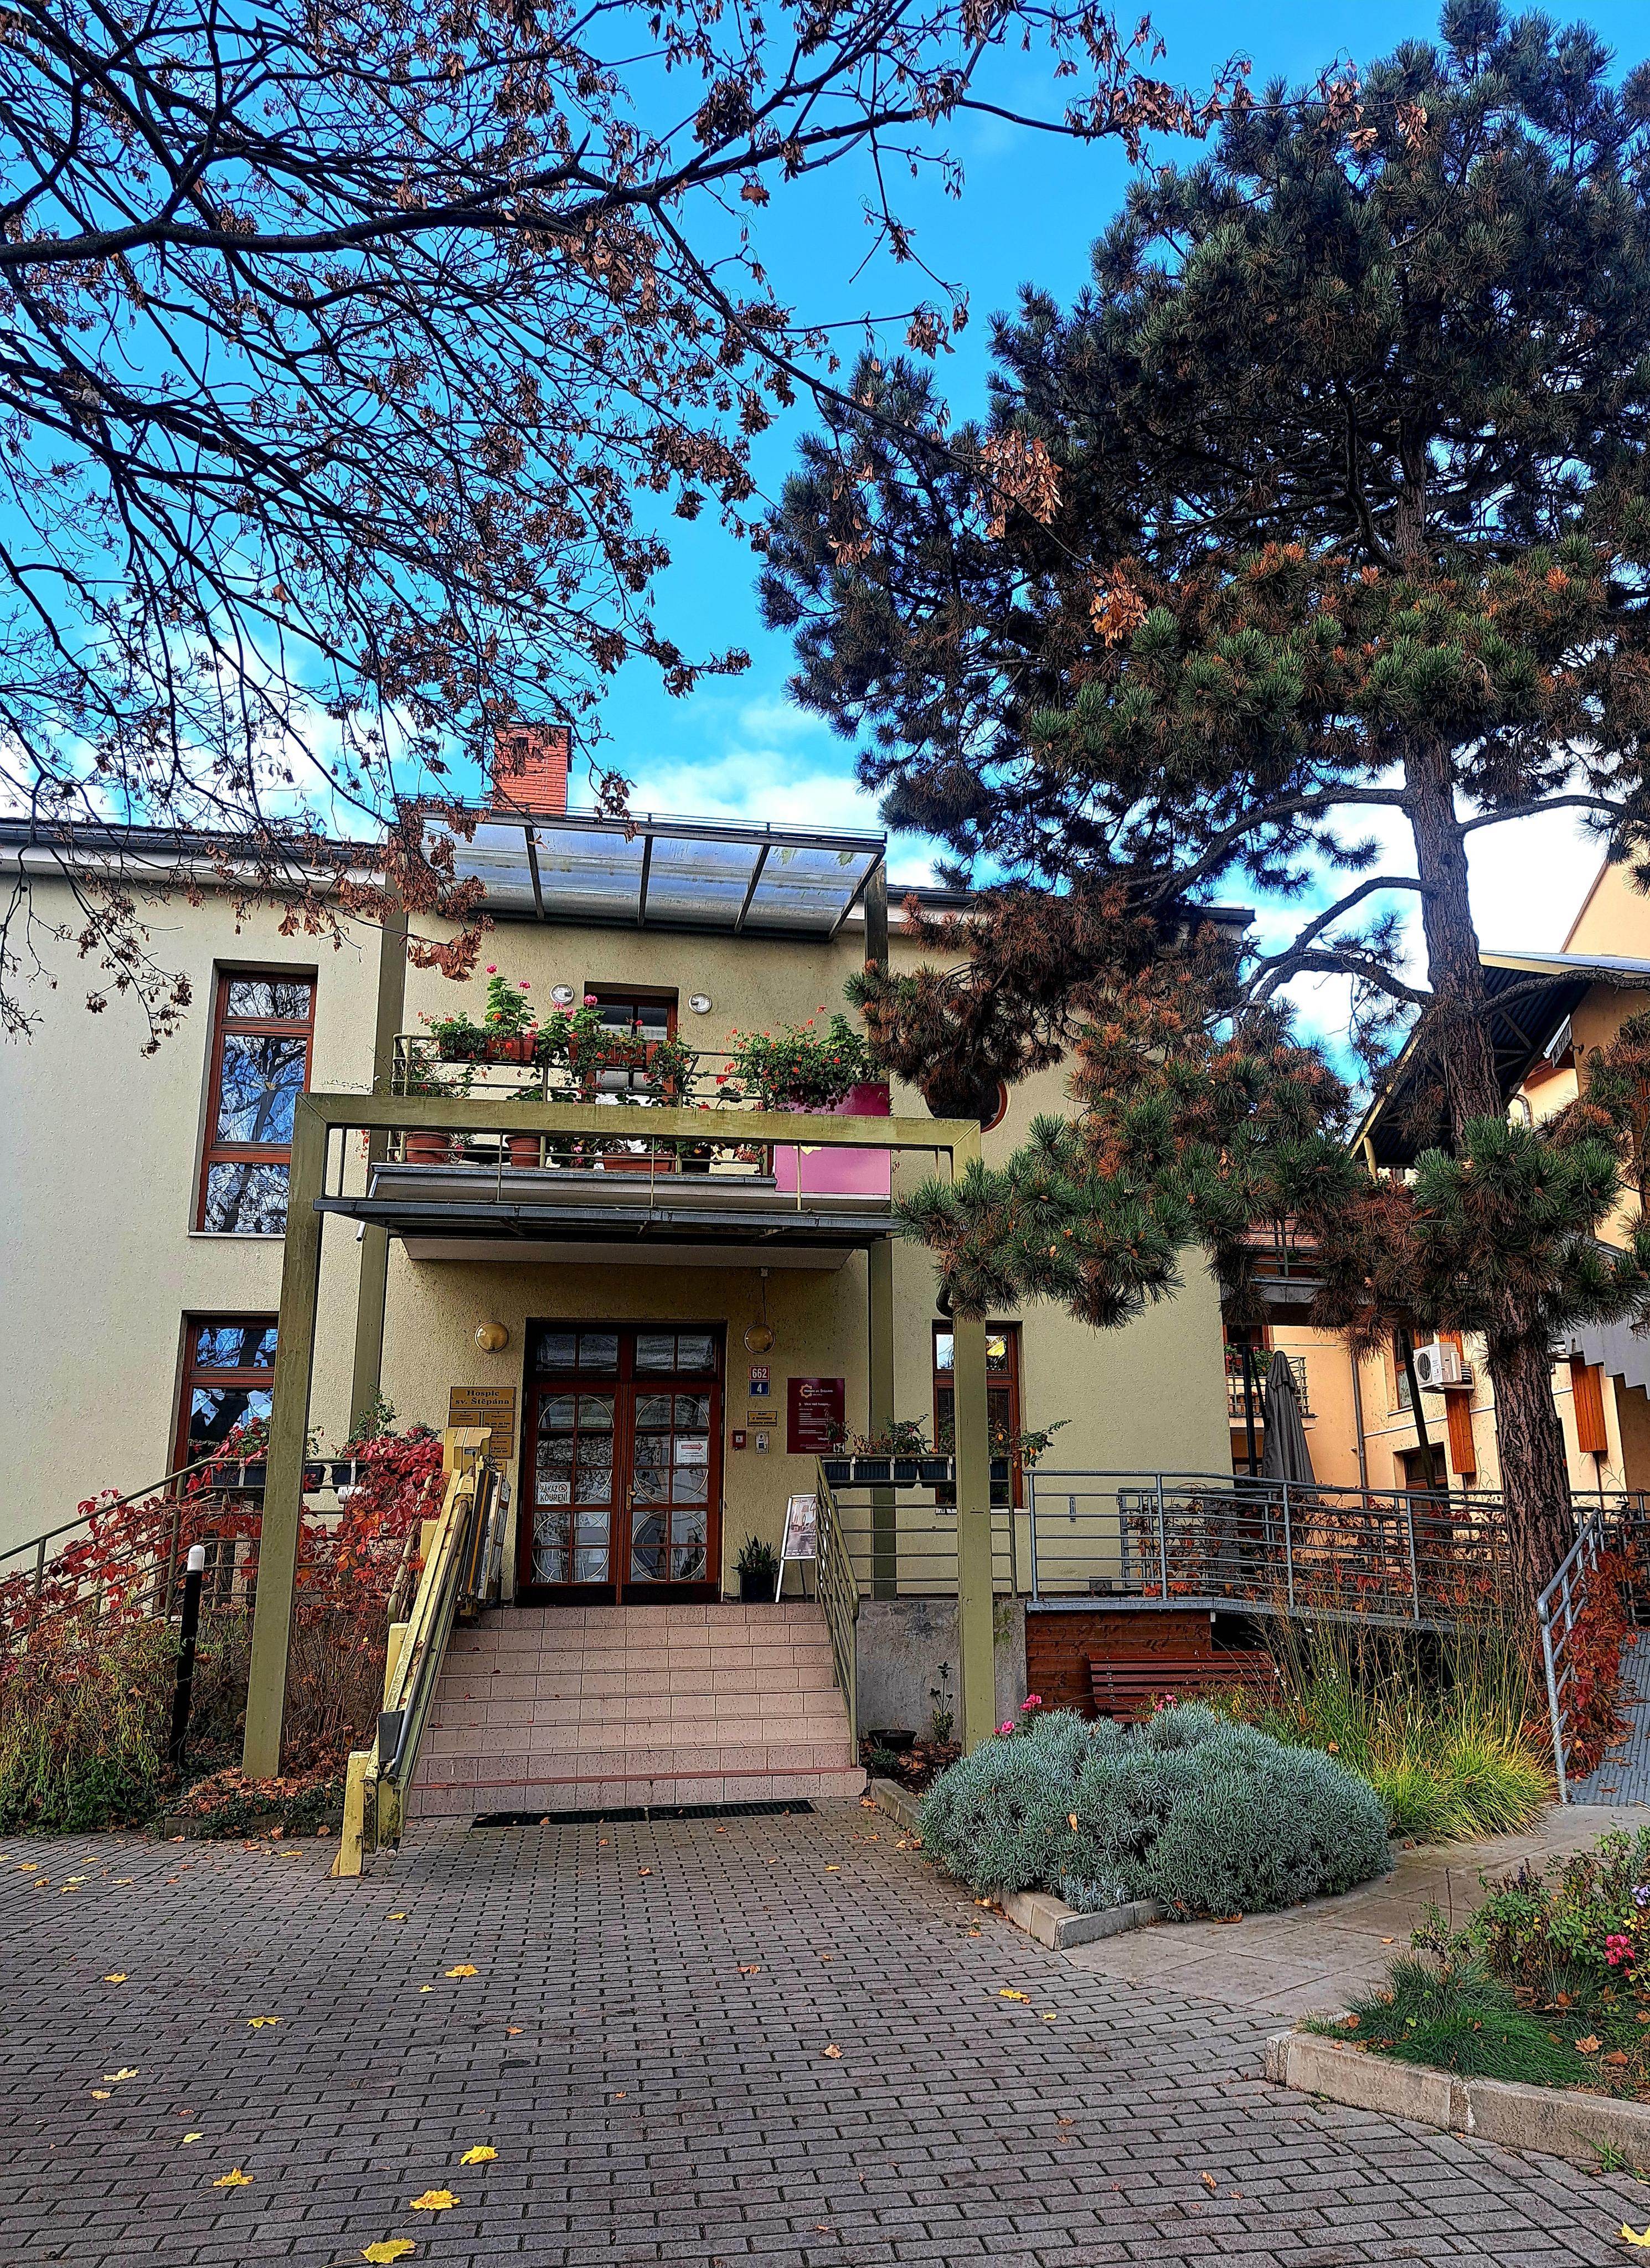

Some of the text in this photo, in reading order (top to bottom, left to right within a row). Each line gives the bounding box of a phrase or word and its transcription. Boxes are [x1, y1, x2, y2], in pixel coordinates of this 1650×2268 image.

[752, 1368, 767, 1378] 662
[756, 1383, 762, 1393] 4
[471, 1396, 509, 1405] Štěpána
